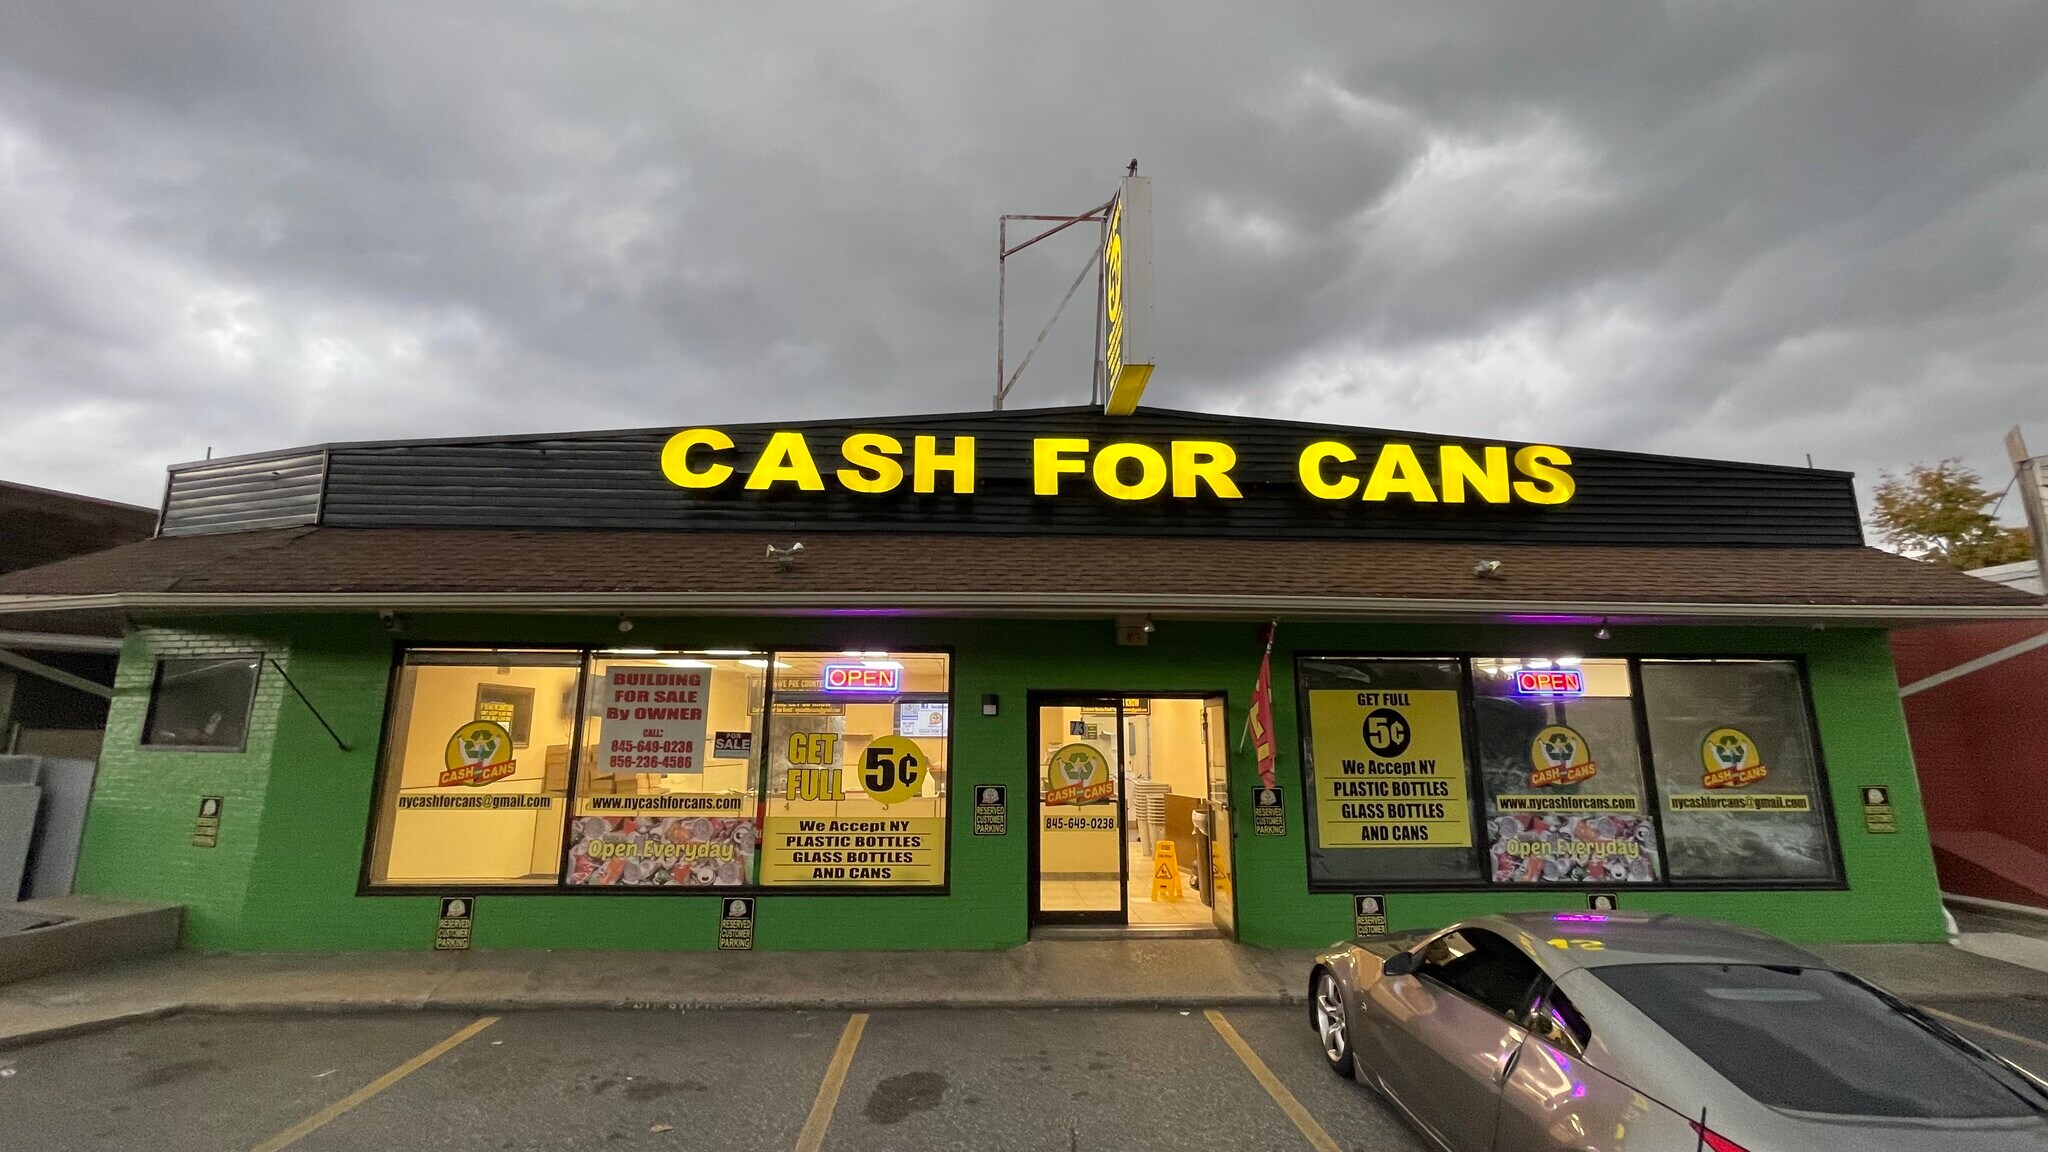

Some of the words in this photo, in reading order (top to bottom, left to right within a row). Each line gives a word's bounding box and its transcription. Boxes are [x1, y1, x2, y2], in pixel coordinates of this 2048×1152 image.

[660, 429, 976, 494] CASH
[1033, 438, 1244, 500] FOR
[1298, 441, 1576, 505] CANS
[613, 672, 702, 686] BUILDING
[801, 680, 825, 688] COUNTE
[829, 669, 894, 687] OPEN
[1520, 674, 1580, 690] OPEN
[614, 690, 650, 703] FOR
[653, 690, 698, 703] SALE
[1357, 693, 1380, 706] GET
[1383, 693, 1411, 706] FULL
[606, 707, 631, 721] By
[634, 707, 703, 720] OWNER
[642, 728, 664, 737] CALL:
[1368, 717, 1405, 749] 5¢
[610, 740, 693, 753] 845-649-0238
[715, 738, 750, 750] SALE
[788, 732, 839, 765] GET
[609, 755, 692, 768] 856-236-4586
[1342, 760, 1365, 775] We
[1368, 760, 1417, 776] Accept
[1419, 760, 1436, 774] NY
[441, 766, 475, 784] CASH
[482, 762, 515, 779] CANS
[865, 747, 918, 792] 5¢
[1531, 767, 1560, 784] CASH
[1566, 764, 1596, 780] CANS
[1703, 770, 1732, 786] CASH
[1739, 766, 1767, 782] CANS
[786, 768, 846, 801] FULL
[1333, 781, 1389, 797] PLASTIC
[1392, 781, 1449, 797] BOTTLES
[1047, 787, 1076, 803] CASH
[1084, 783, 1113, 799] CANS
[399, 794, 551, 809] nycashforcans@gmail.com
[592, 796, 741, 810] www.nycashforcans.com
[1499, 797, 1636, 811] www.nycashforcans.com
[1671, 796, 1807, 810] nycashforcans@gmail.com
[1341, 803, 1385, 819] GLASS
[1388, 803, 1445, 819] BOTTLES
[799, 820, 825, 832] We
[829, 820, 887, 833] Accept
[889, 820, 910, 831] NY
[1046, 818, 1115, 829] 845-649-0238
[1361, 825, 1389, 841] AND
[1392, 825, 1429, 841] CANS
[786, 836, 851, 848] PLASTIC
[855, 836, 921, 848] BOTTLES
[1506, 838, 1552, 859] Open
[1556, 838, 1640, 861] Everyday
[587, 838, 638, 858] Open
[643, 839, 735, 862] Everyday
[792, 851, 843, 863] GLASS
[846, 851, 913, 863] BOTTLES
[812, 867, 845, 879] AND
[849, 867, 891, 879] CANS
